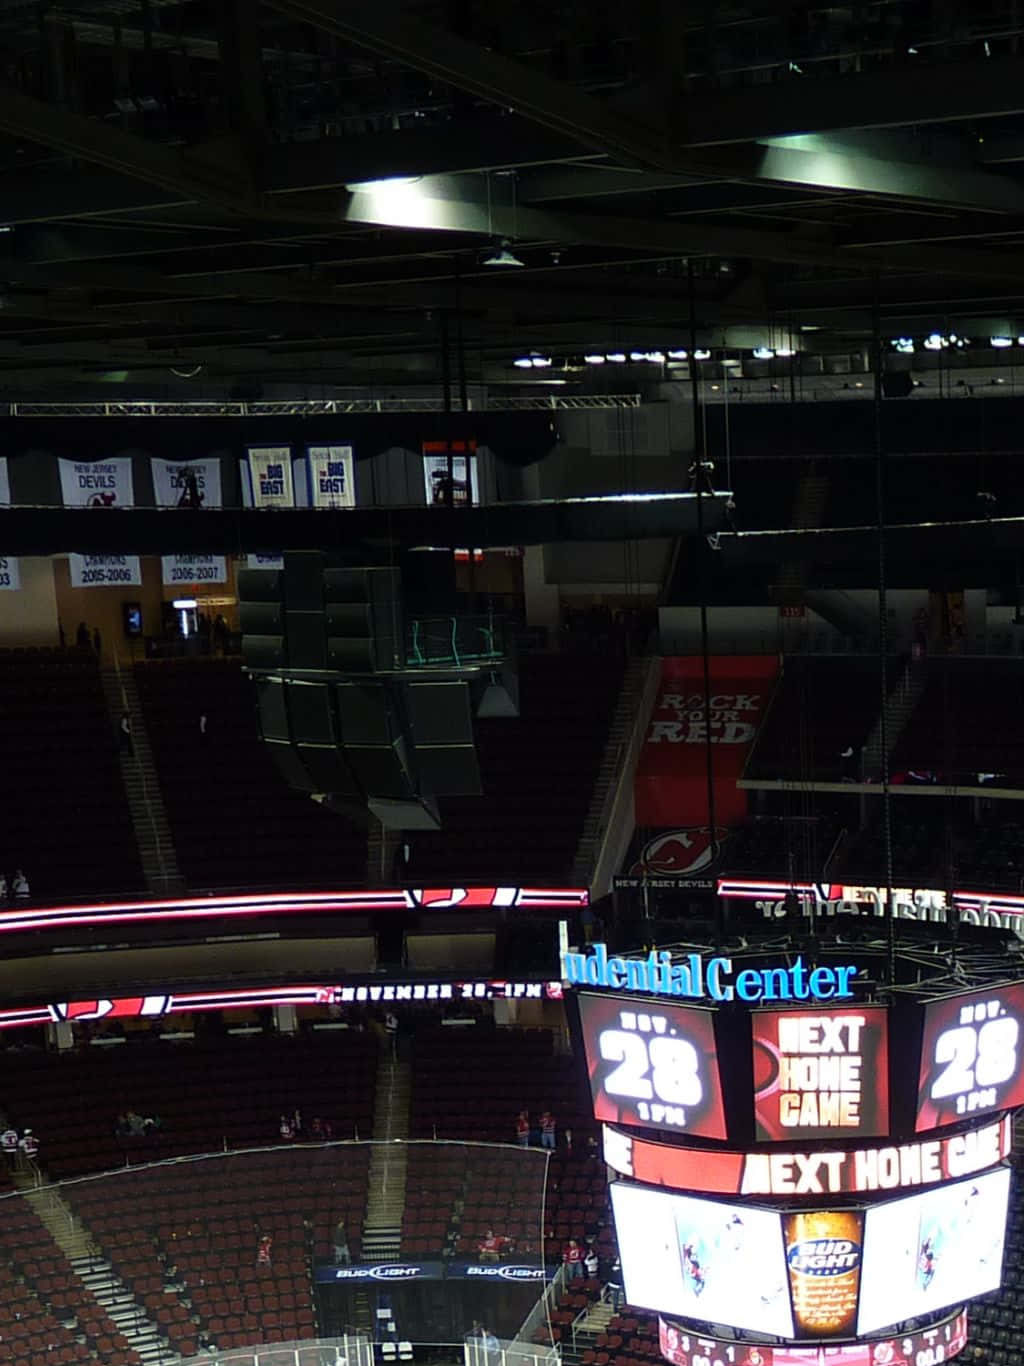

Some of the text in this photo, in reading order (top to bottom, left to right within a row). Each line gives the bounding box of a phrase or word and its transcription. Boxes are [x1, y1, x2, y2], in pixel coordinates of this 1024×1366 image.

[267, 464, 283, 479] BIG
[327, 462, 344, 477] BIG
[79, 475, 116, 489] DEVILS
[260, 480, 284, 495] EAST
[320, 478, 345, 493] EAST
[647, 720, 754, 744] RED
[562, 943, 856, 1001] udential Center
[341, 984, 452, 1001] NOVEMBER
[779, 1016, 865, 1052] NEXT
[600, 1030, 702, 1106] 28
[931, 1018, 1018, 1099] 28
[780, 1057, 861, 1091] HOME
[780, 1093, 860, 1126] GAME
[742, 1152, 845, 1194] NEXT
[855, 1142, 941, 1190] HOME
[336, 1267, 421, 1278] BUD LIGHT
[467, 1267, 545, 1278] BUD LIGHT
